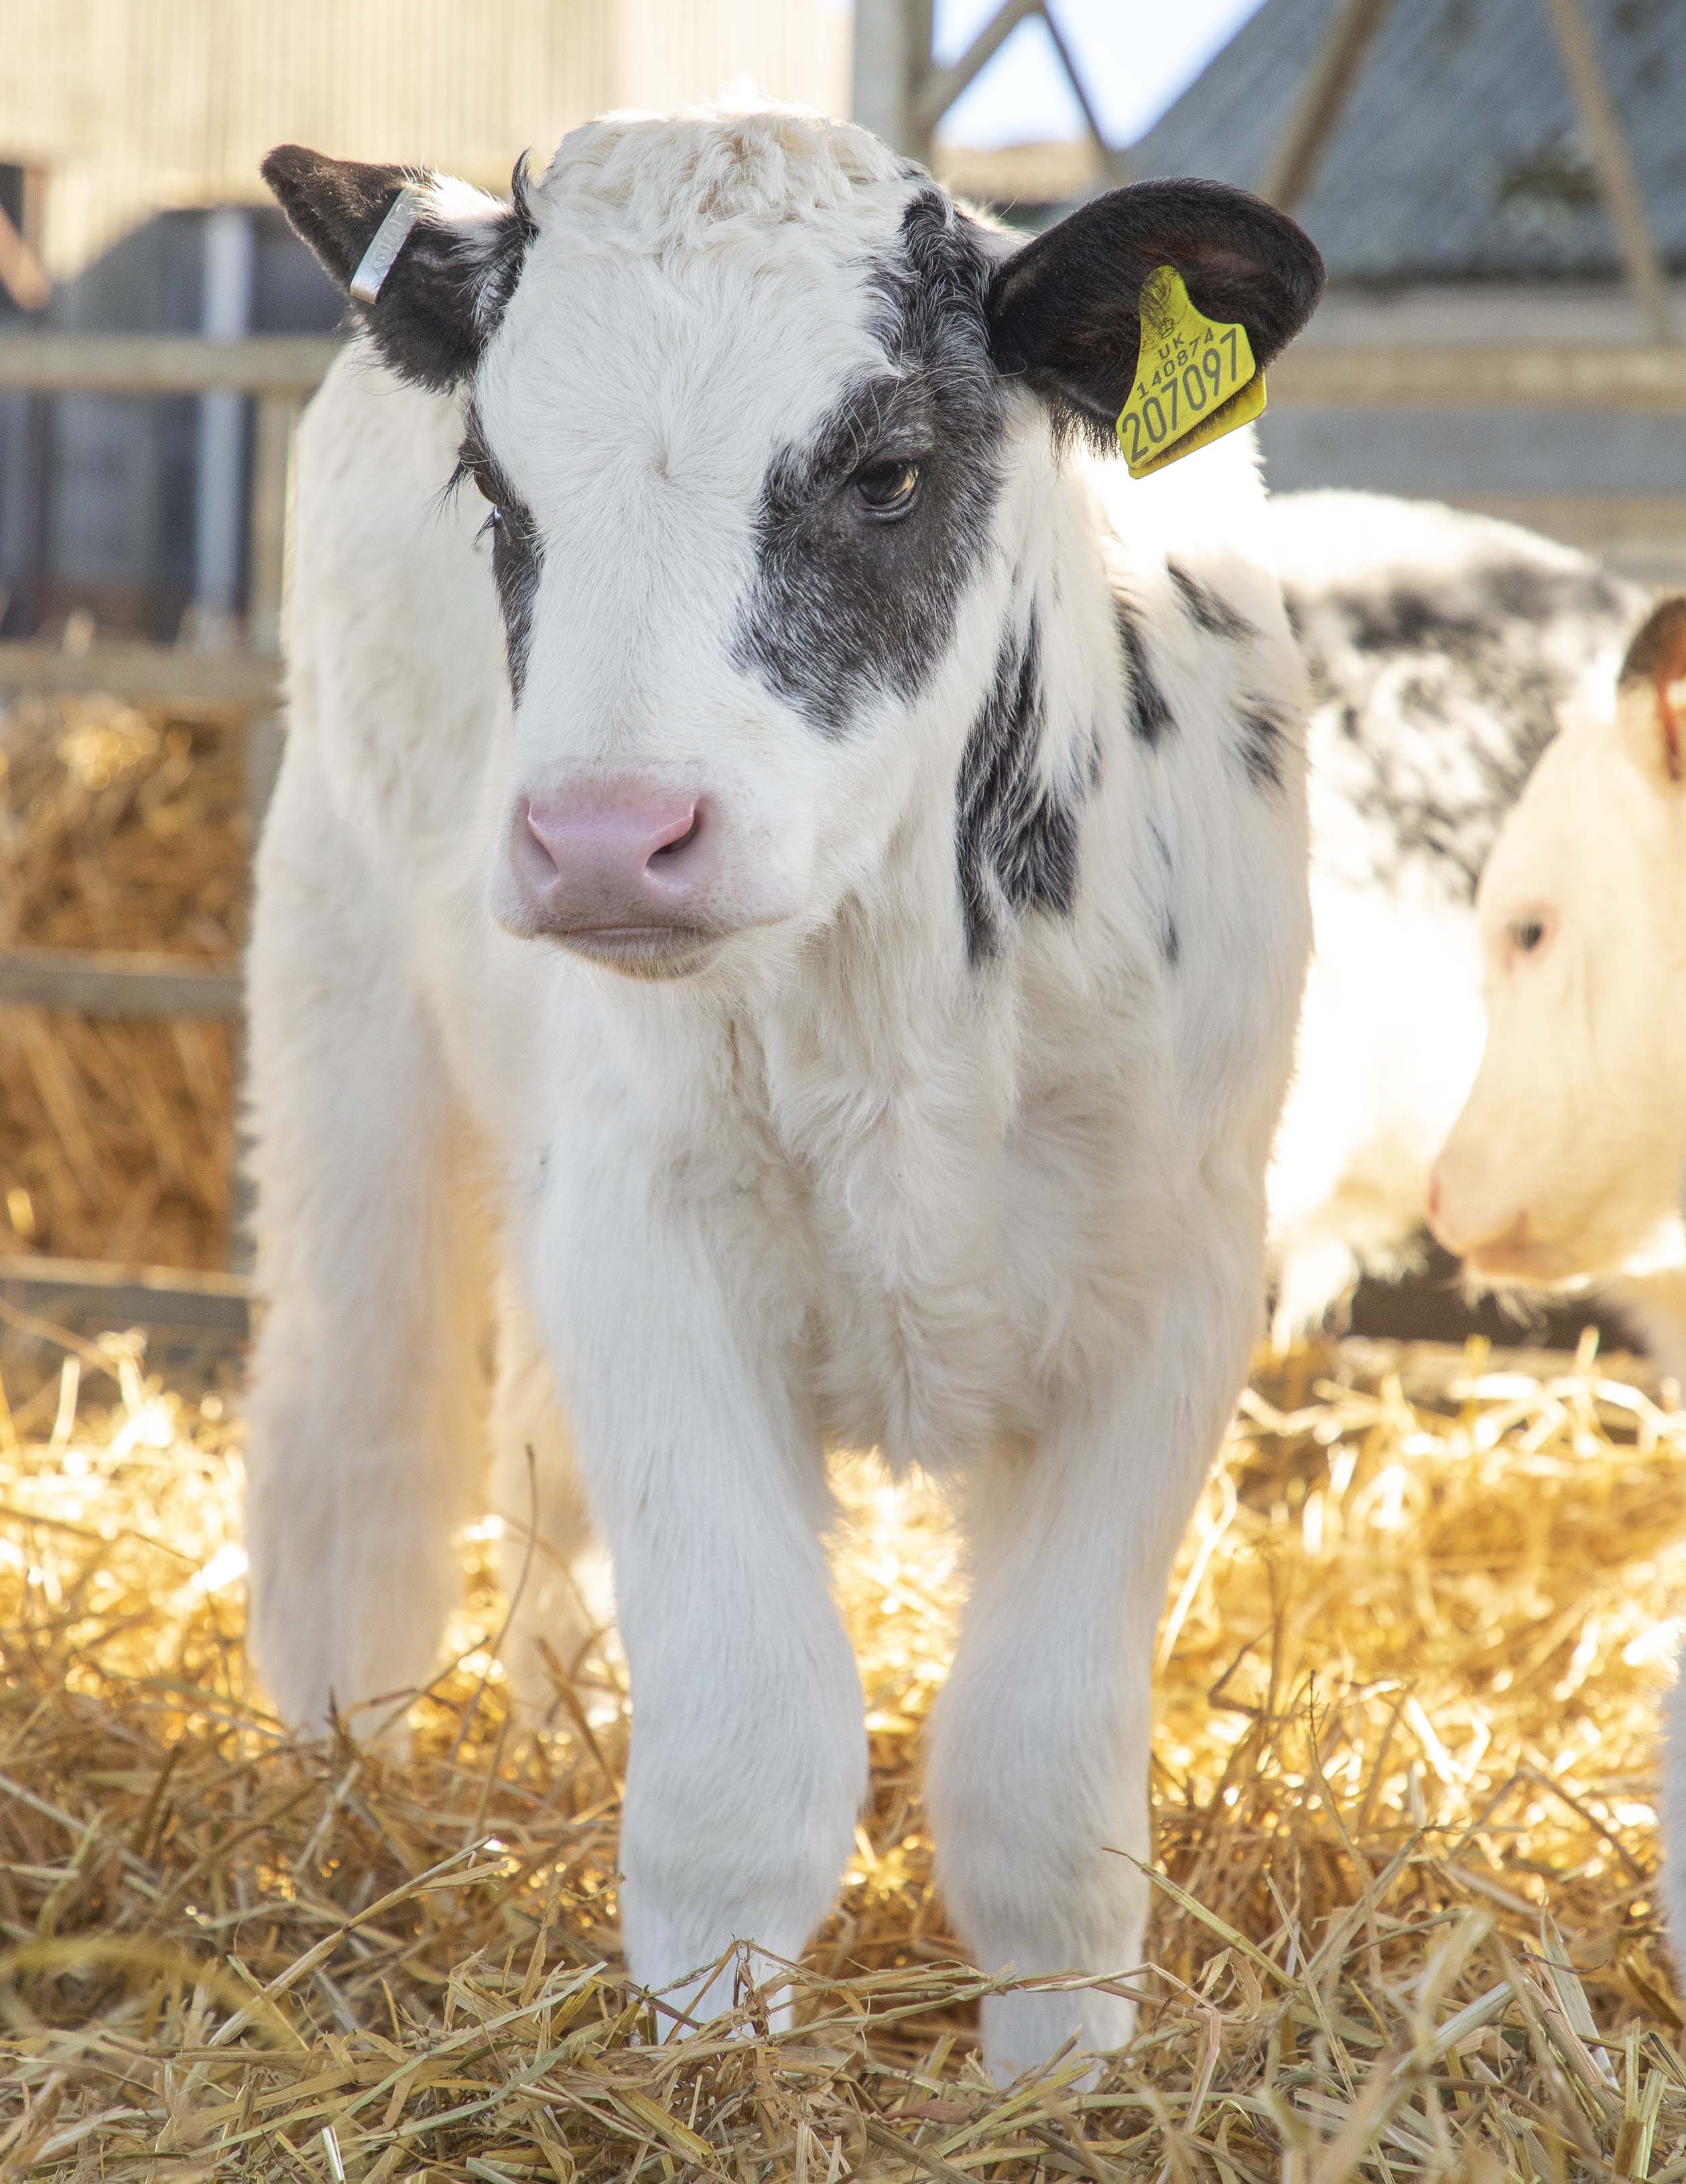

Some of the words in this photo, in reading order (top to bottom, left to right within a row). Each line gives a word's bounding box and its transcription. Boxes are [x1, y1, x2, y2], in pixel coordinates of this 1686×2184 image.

[1137, 327, 1214, 399] 140874
[1158, 332, 1184, 359] UK
[1122, 327, 1237, 463] 207097
